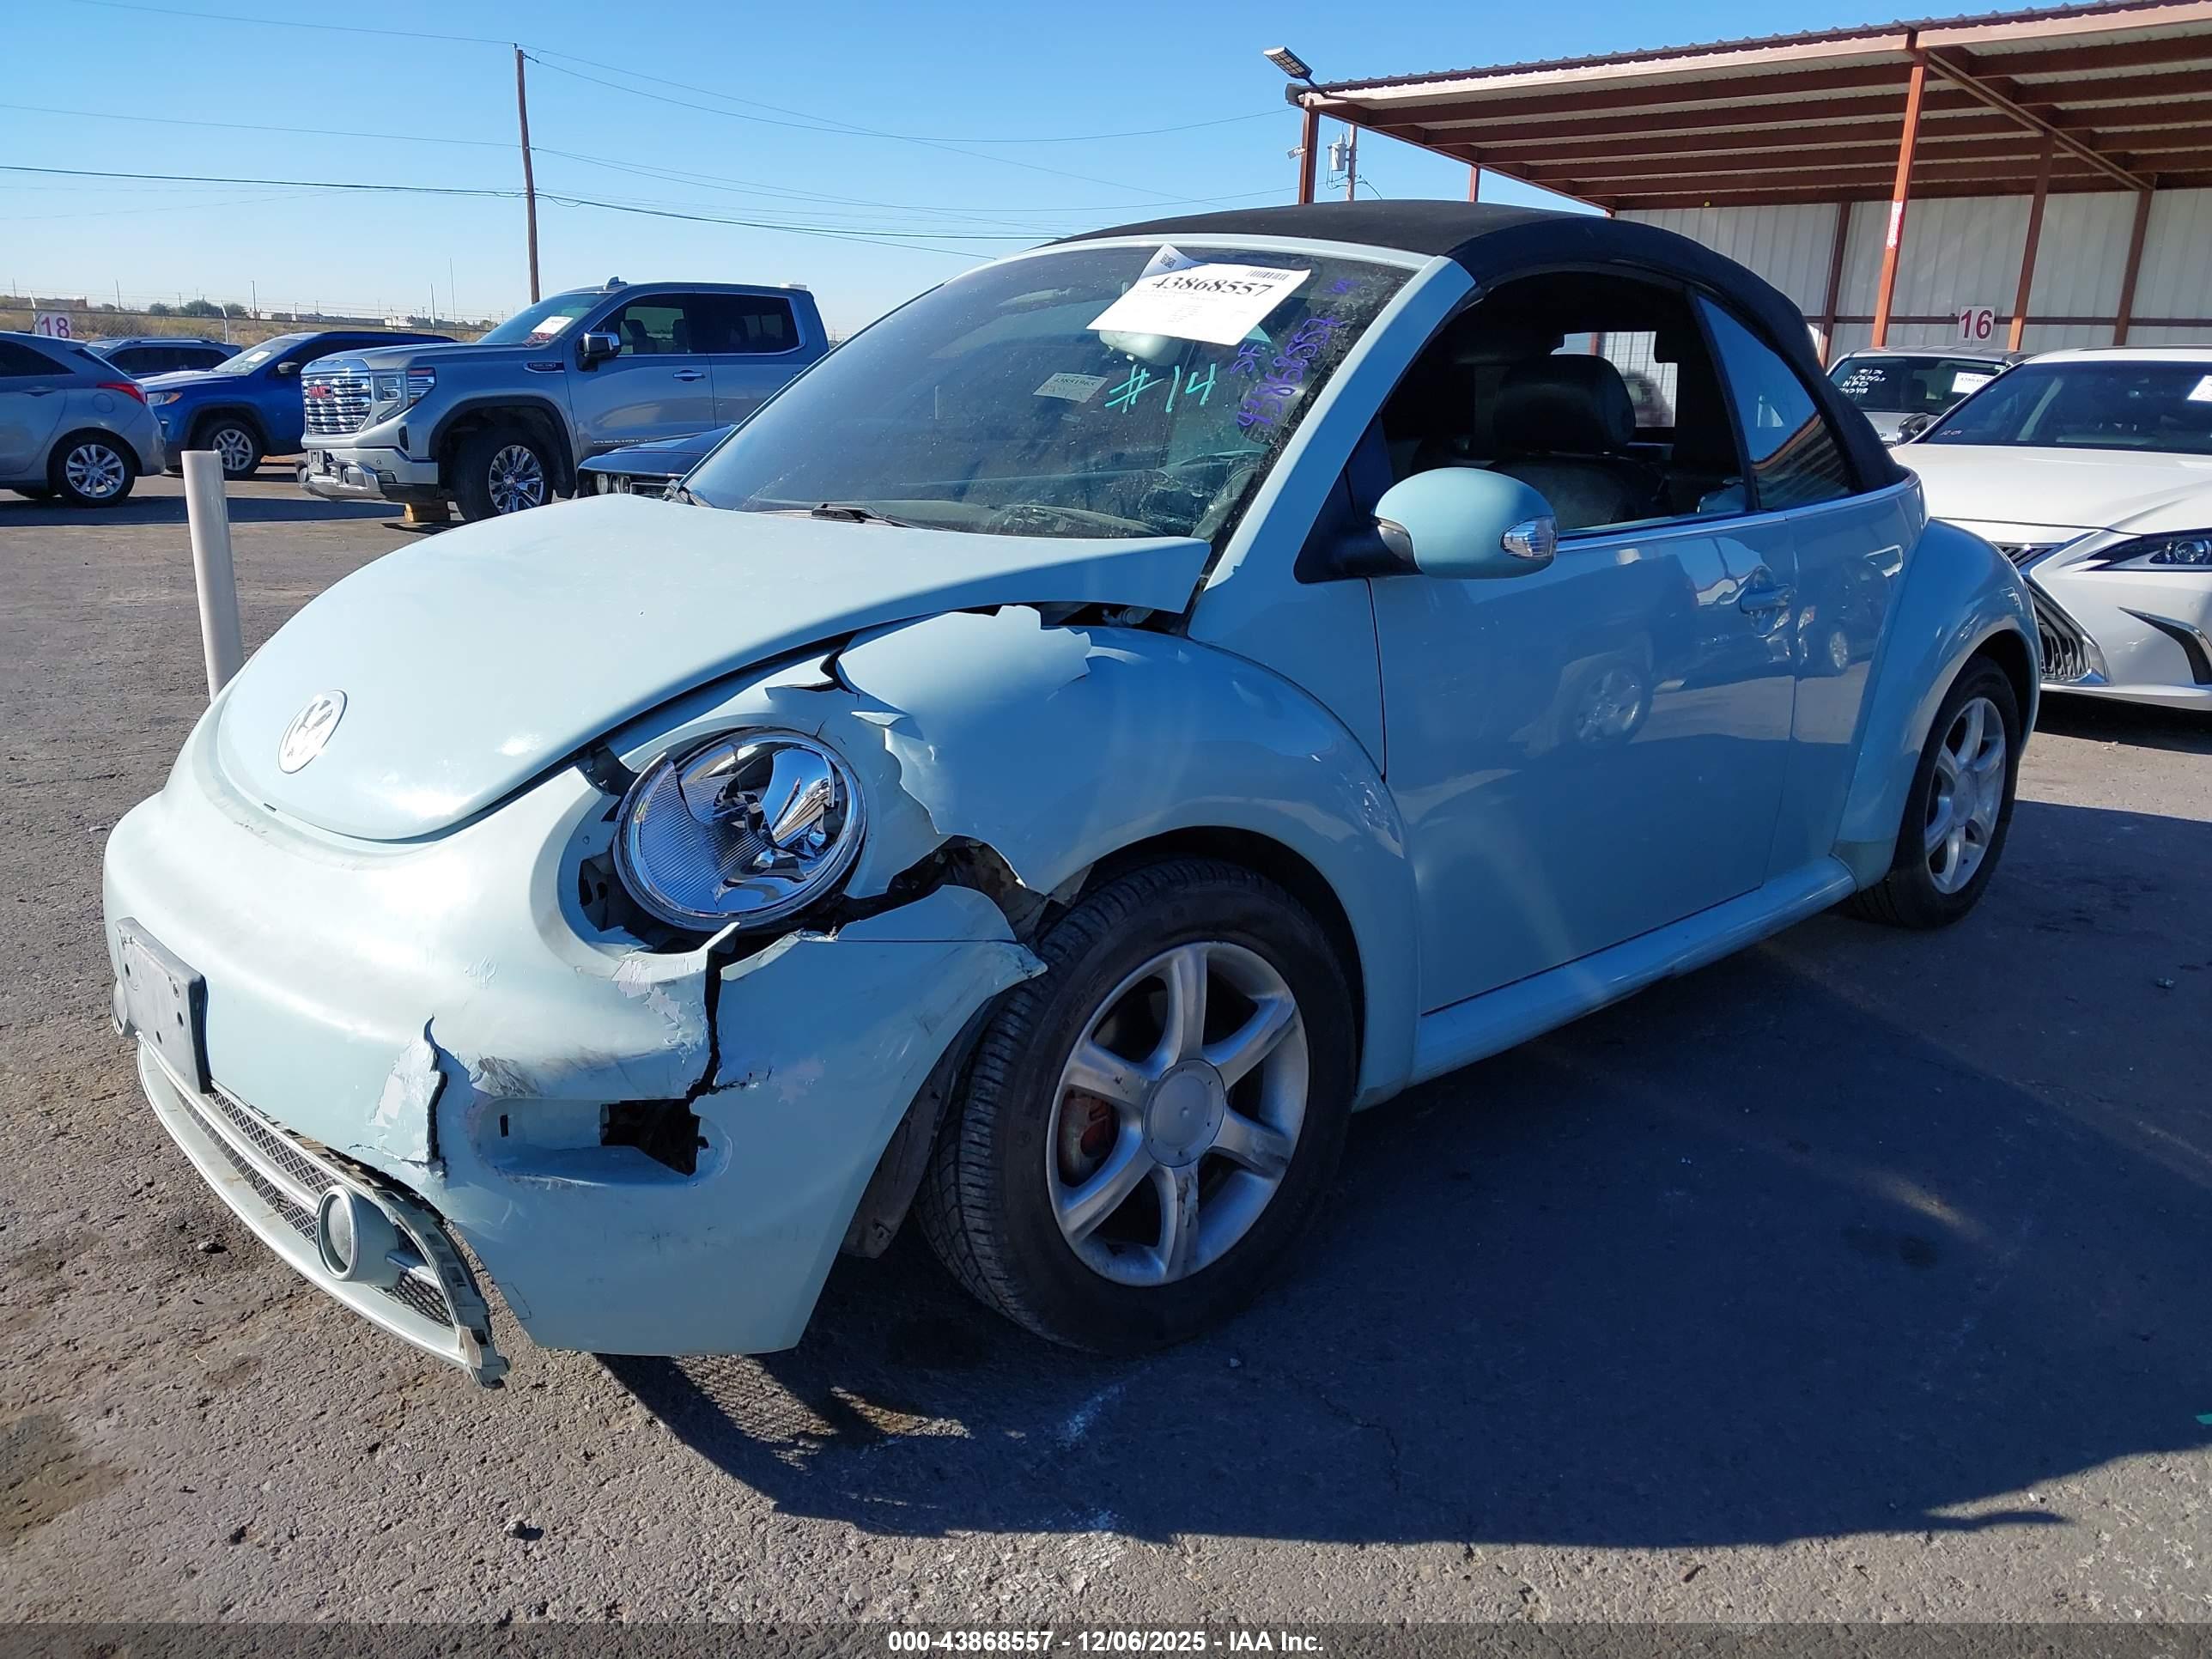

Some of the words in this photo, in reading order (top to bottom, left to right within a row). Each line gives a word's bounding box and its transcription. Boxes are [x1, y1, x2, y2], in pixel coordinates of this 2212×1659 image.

[1152, 276, 1275, 298] 43868557
[41, 316, 70, 338] 18
[1960, 309, 1993, 339] 16
[1104, 363, 1217, 413] #14
